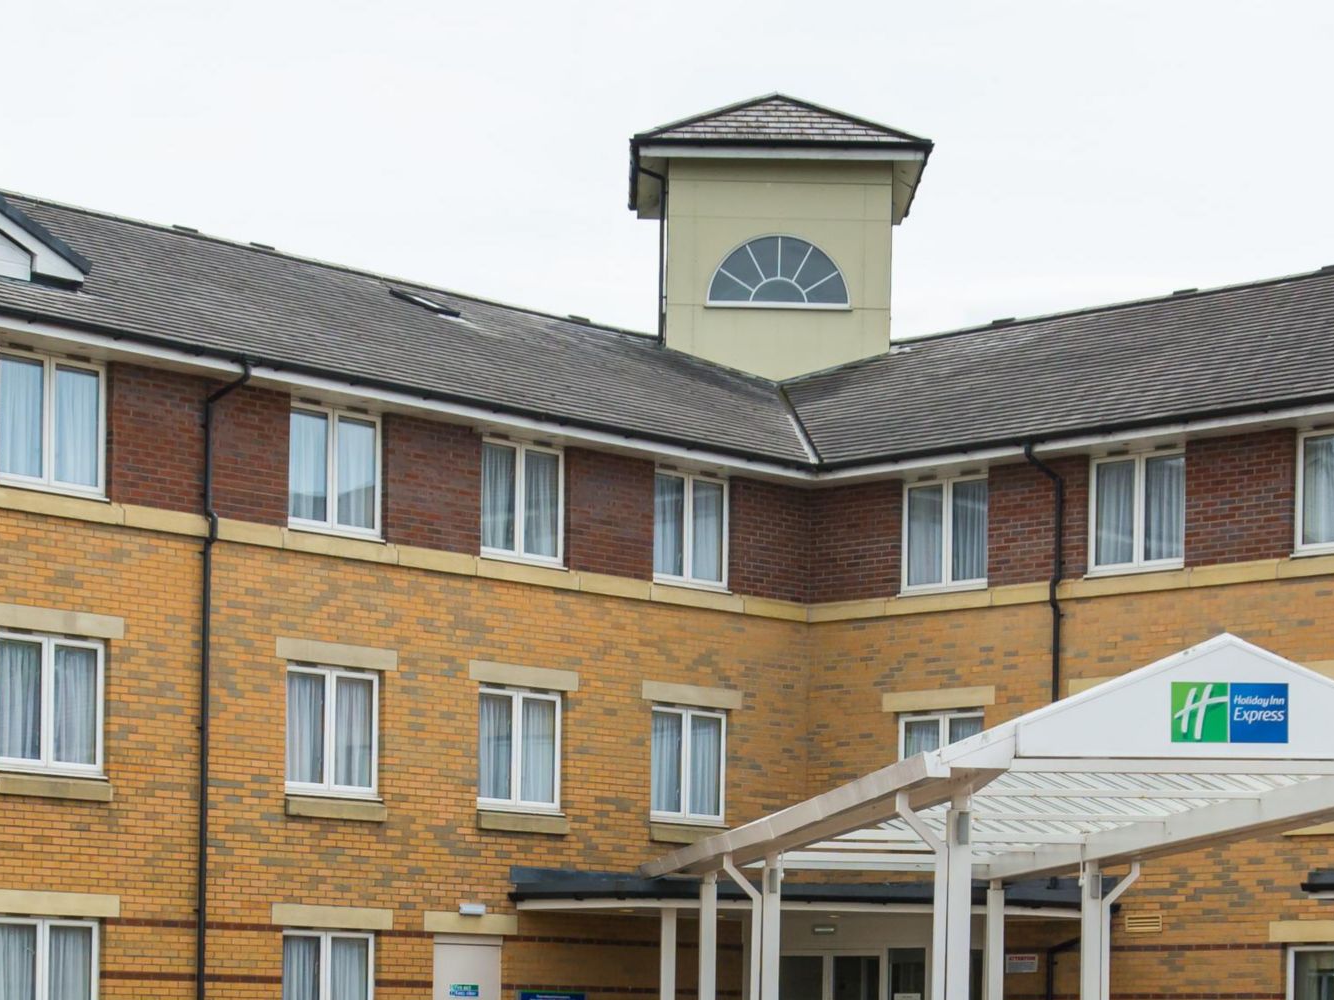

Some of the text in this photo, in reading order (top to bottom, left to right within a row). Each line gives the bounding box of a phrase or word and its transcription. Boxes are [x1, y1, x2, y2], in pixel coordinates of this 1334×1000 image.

[1233, 695, 1285, 707] Holiday Inn
[1233, 706, 1285, 724] Express
